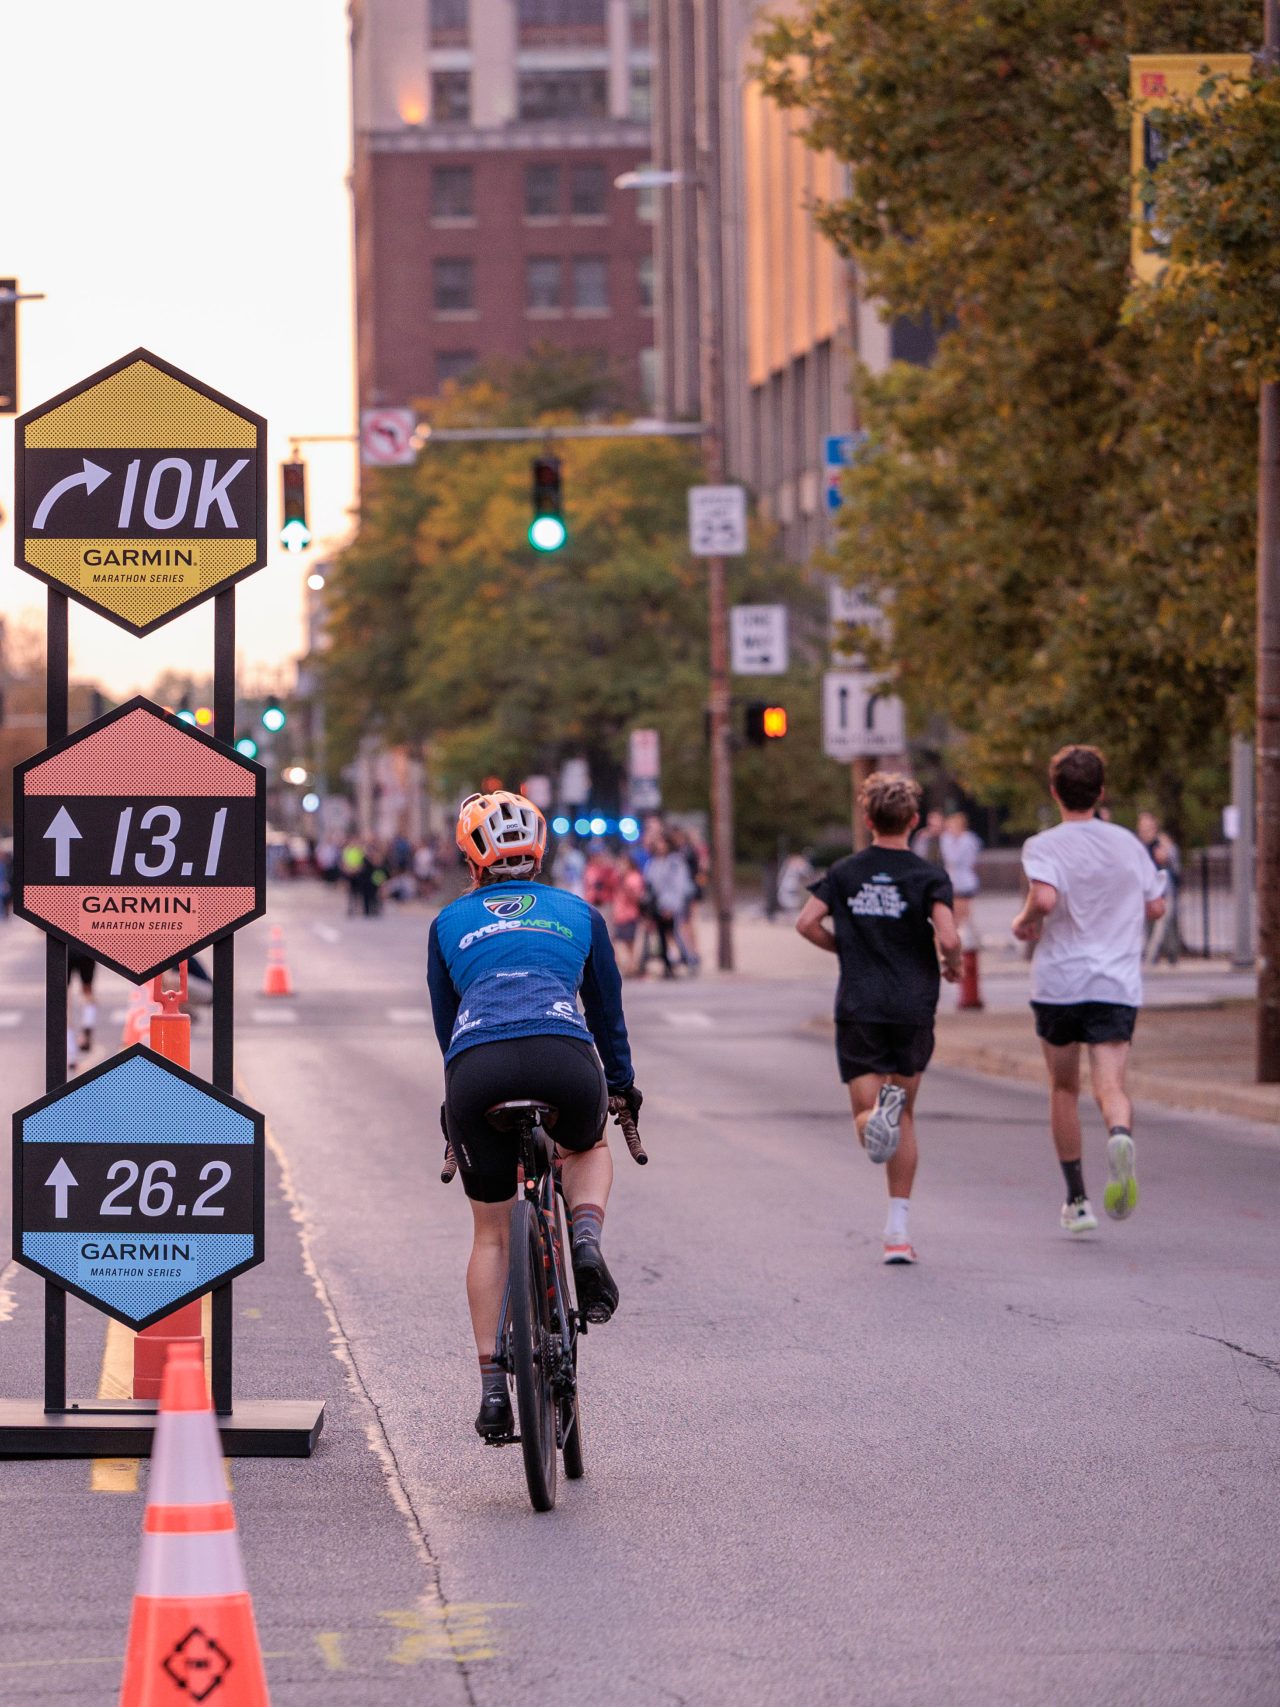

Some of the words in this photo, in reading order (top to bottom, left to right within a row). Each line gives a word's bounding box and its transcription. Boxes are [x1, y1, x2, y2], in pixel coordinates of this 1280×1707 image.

[117, 457, 251, 530] 10K
[83, 549, 193, 567] GARMIN
[92, 574, 146, 583] MARATHON
[150, 574, 185, 583] SERIES
[110, 805, 228, 878] 13.1
[82, 896, 192, 914] GARMIN
[91, 921, 145, 930] MARATHON
[148, 921, 183, 930] SERIES
[99, 1159, 232, 1217] 26.2
[81, 1242, 191, 1261] GARMIN
[90, 1267, 144, 1277] MARATHON
[147, 1268, 182, 1278] SERIES
